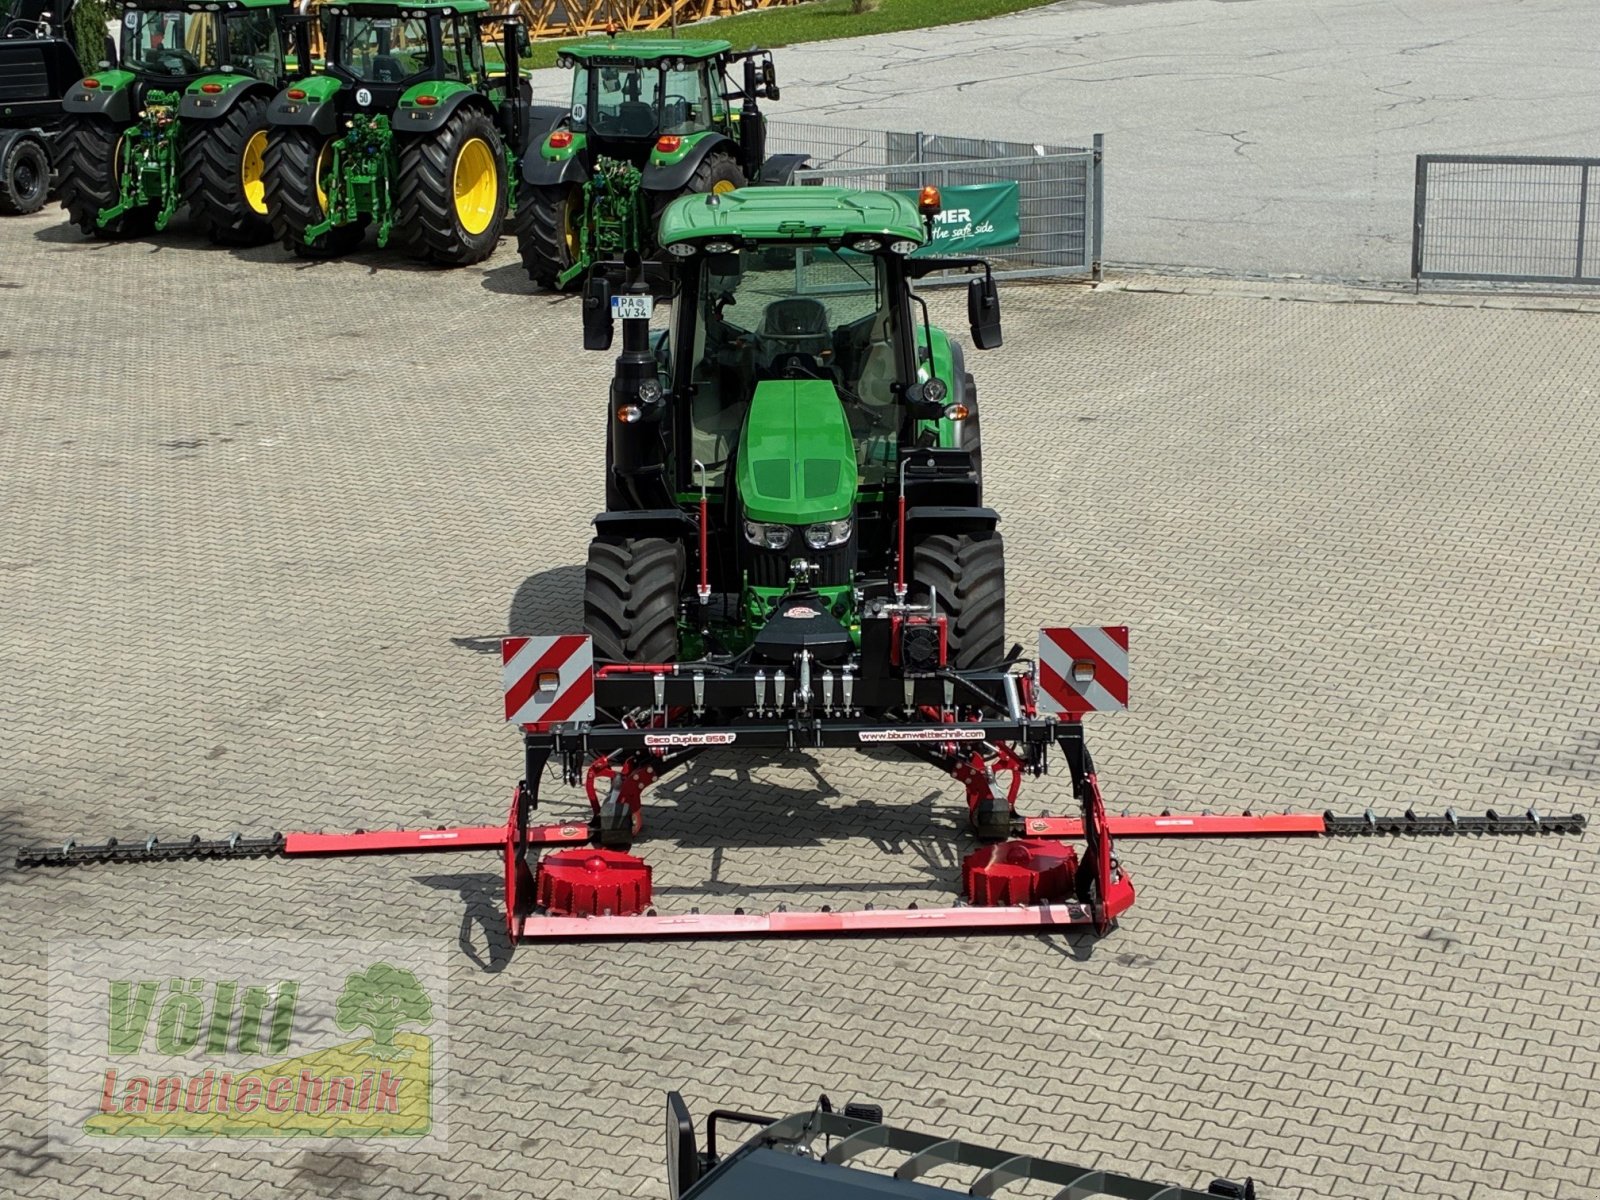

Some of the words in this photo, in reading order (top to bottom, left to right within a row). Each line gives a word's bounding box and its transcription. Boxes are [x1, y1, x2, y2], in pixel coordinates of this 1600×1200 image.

[359, 92, 369, 103] 50
[573, 105, 583, 118] 40
[922, 209, 971, 224] MER
[932, 227, 949, 240] the
[950, 223, 973, 240] safe
[974, 220, 994, 234] side
[621, 298, 634, 307] PA
[617, 307, 631, 317] LV
[634, 308, 646, 317] 34
[647, 736, 670, 744] Seco
[672, 735, 704, 745] Duplex
[861, 731, 984, 740] www.bbumwelttechnik.com
